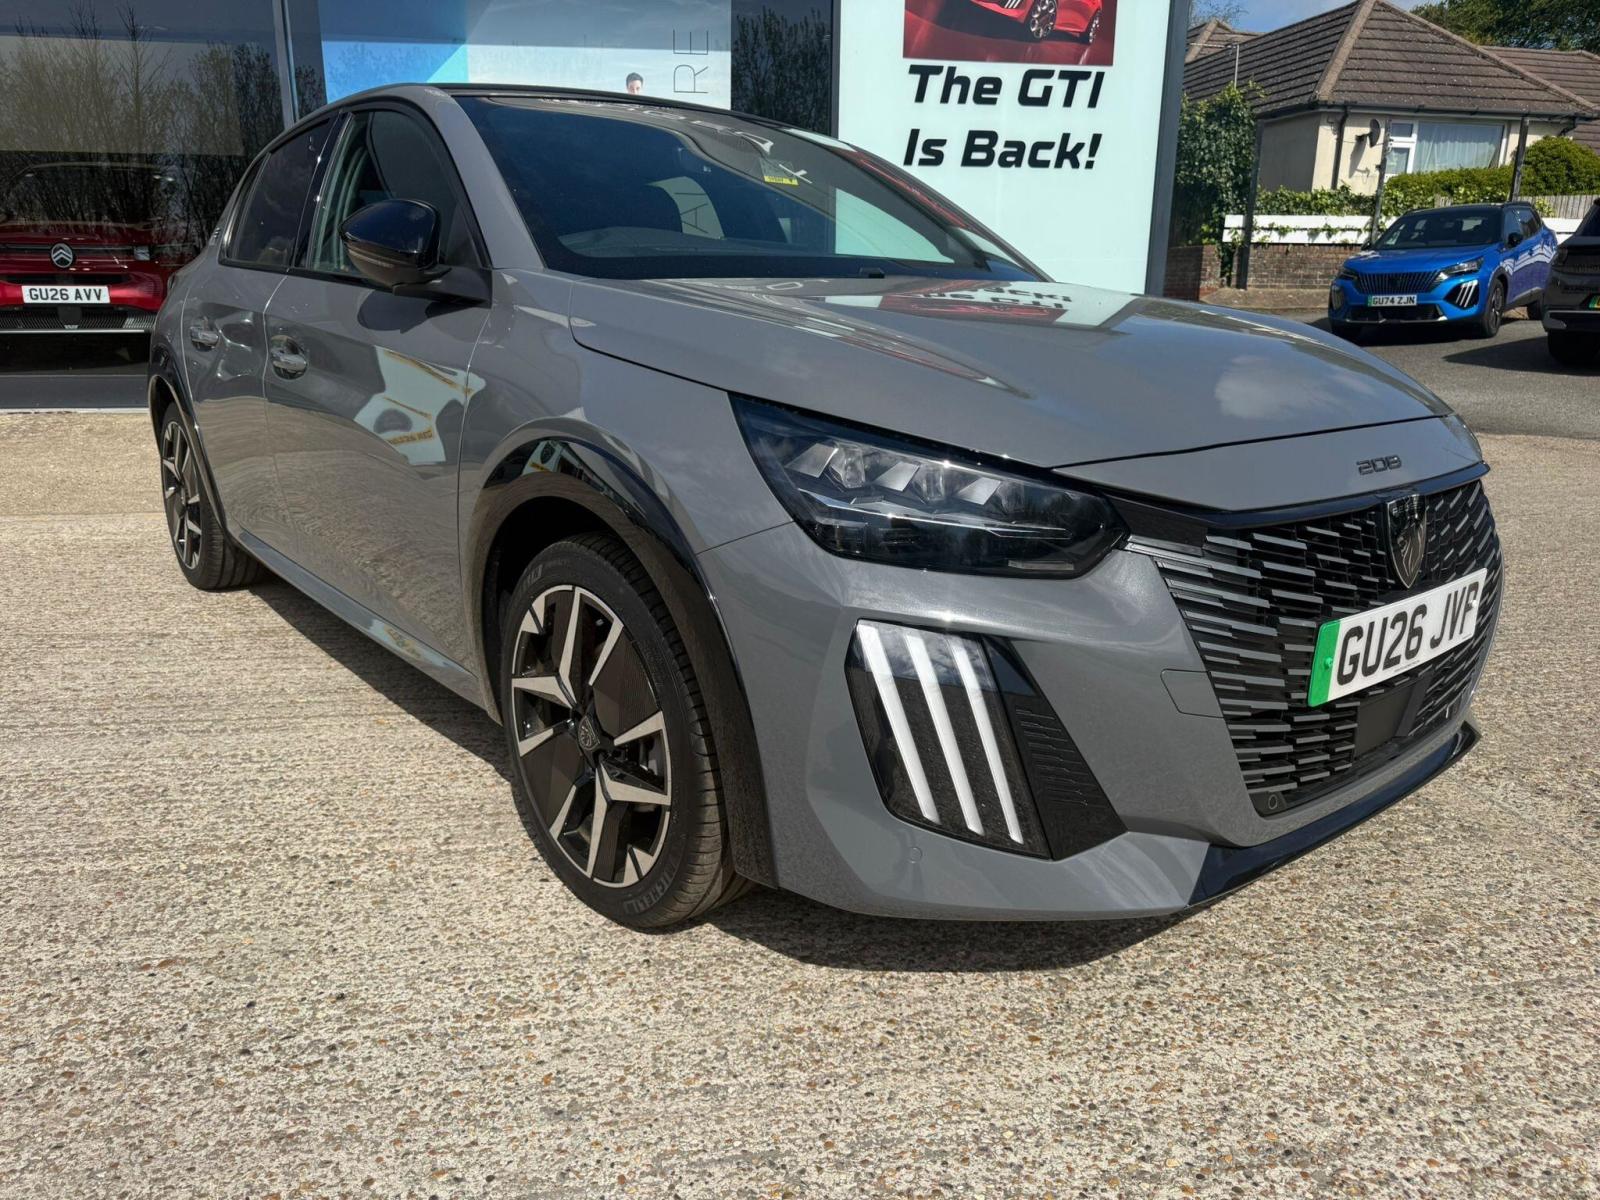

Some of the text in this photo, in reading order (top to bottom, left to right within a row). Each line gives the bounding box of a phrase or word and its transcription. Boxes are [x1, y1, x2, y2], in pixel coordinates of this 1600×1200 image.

[908, 64, 1106, 109] The GTI
[903, 128, 1103, 170] Is Back!
[28, 287, 102, 301] GU26 AVV
[1372, 296, 1395, 305] GU74
[1356, 454, 1402, 476] 208
[1336, 581, 1480, 686] GU26 JVP
